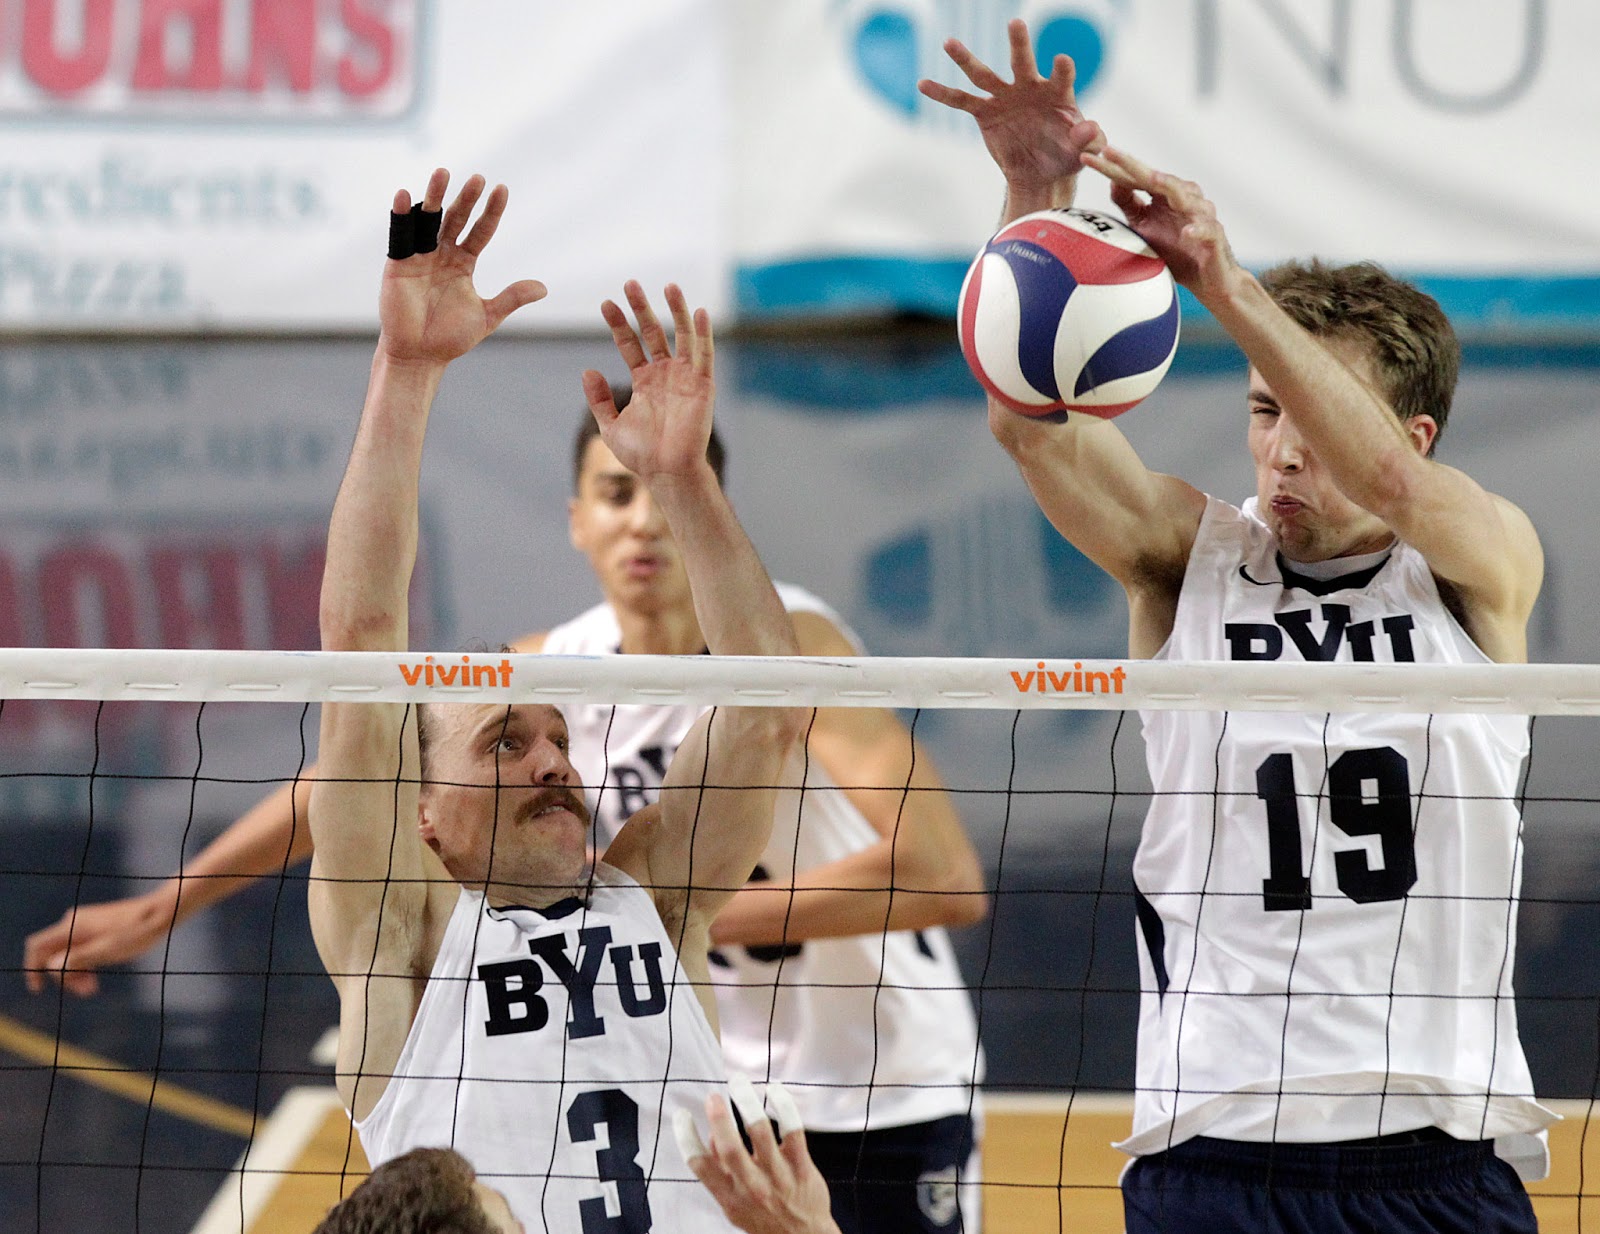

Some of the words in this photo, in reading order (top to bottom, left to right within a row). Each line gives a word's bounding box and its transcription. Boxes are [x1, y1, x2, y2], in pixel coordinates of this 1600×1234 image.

[0, 0, 396, 97] OHNS
[398, 656, 514, 688] vivint
[1010, 661, 1127, 694] vivint
[1255, 746, 1418, 911] 19
[477, 925, 667, 1040] BYU
[566, 1088, 652, 1234] 3
